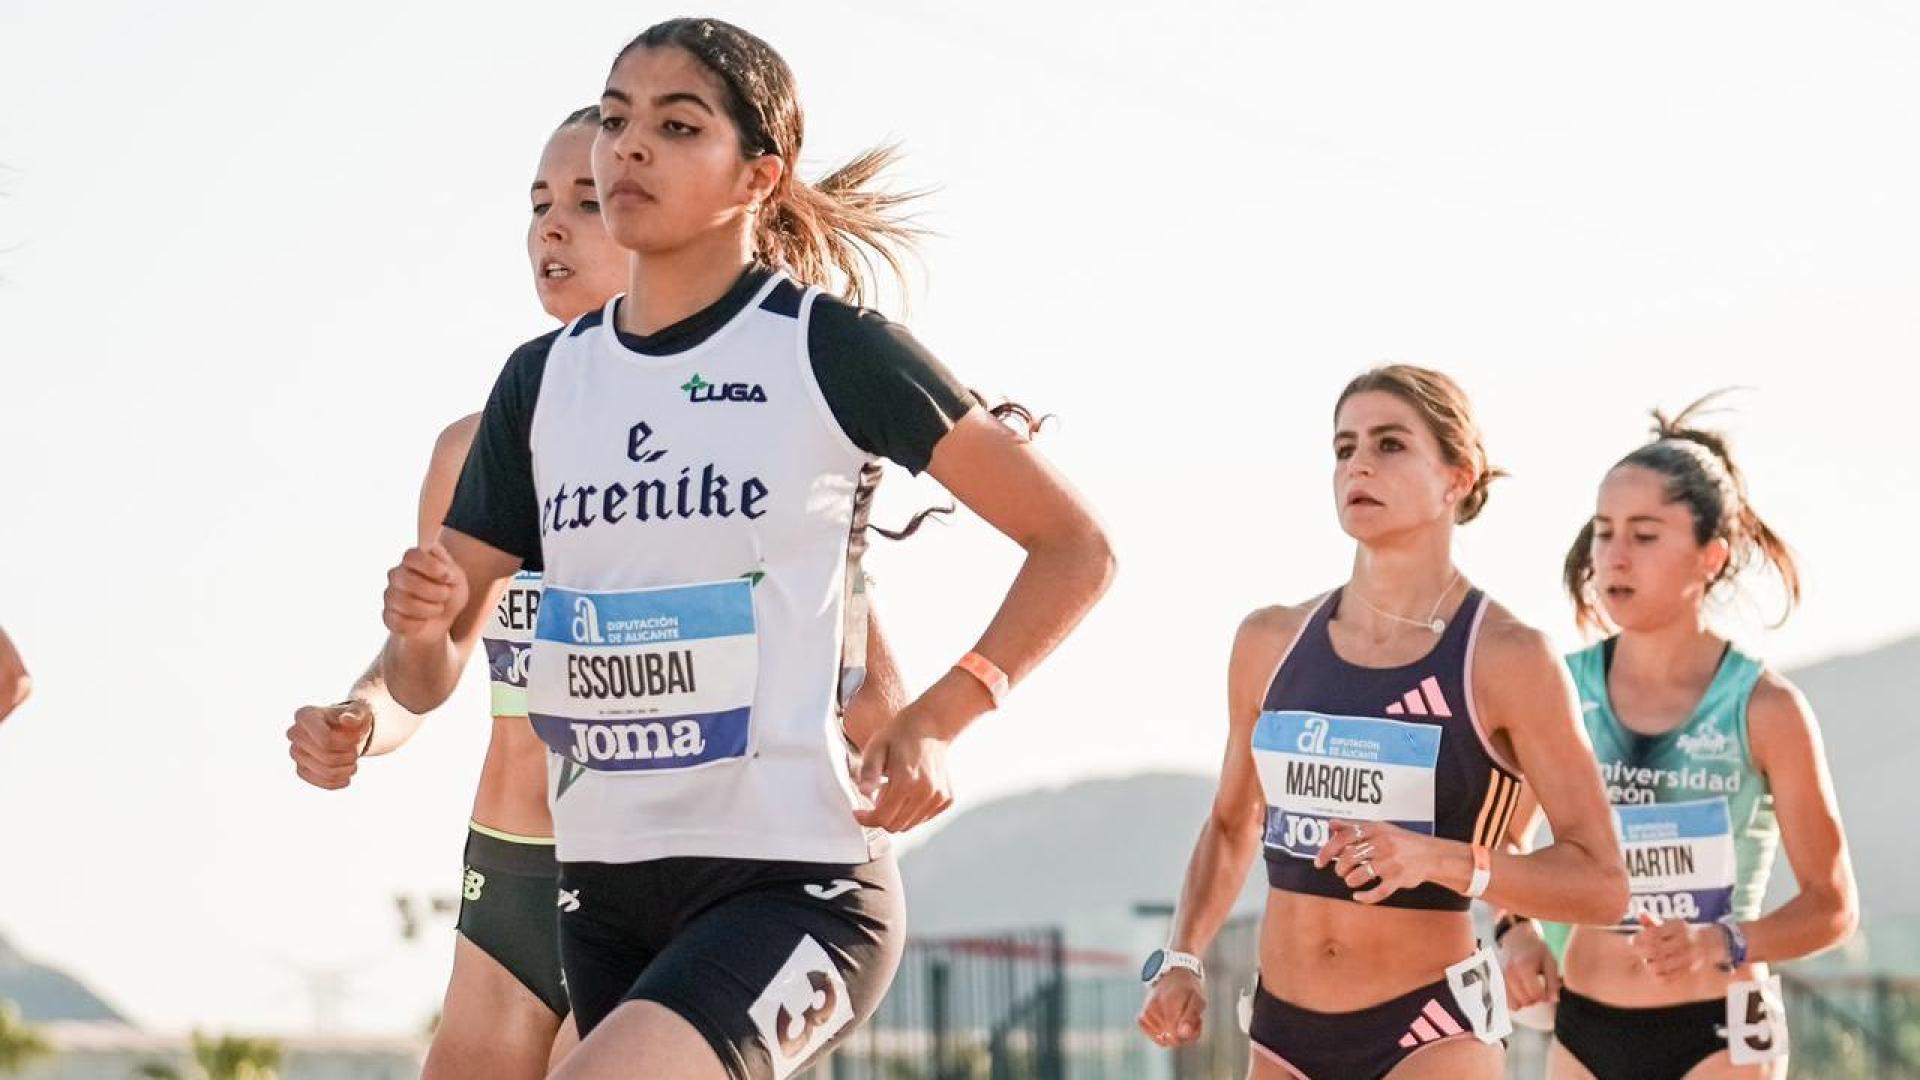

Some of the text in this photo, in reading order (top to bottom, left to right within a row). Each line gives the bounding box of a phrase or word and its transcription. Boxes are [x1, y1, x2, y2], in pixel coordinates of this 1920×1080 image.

[689, 382, 768, 402] LUGA
[608, 628, 679, 643] DE ALICANTE
[568, 650, 696, 699] ESSOUBAI
[1286, 760, 1384, 805] MARQUES
[1600, 760, 1741, 793] niversidad
[1608, 783, 1656, 805] eón
[776, 970, 837, 1057] 3
[1461, 961, 1494, 1032] 7
